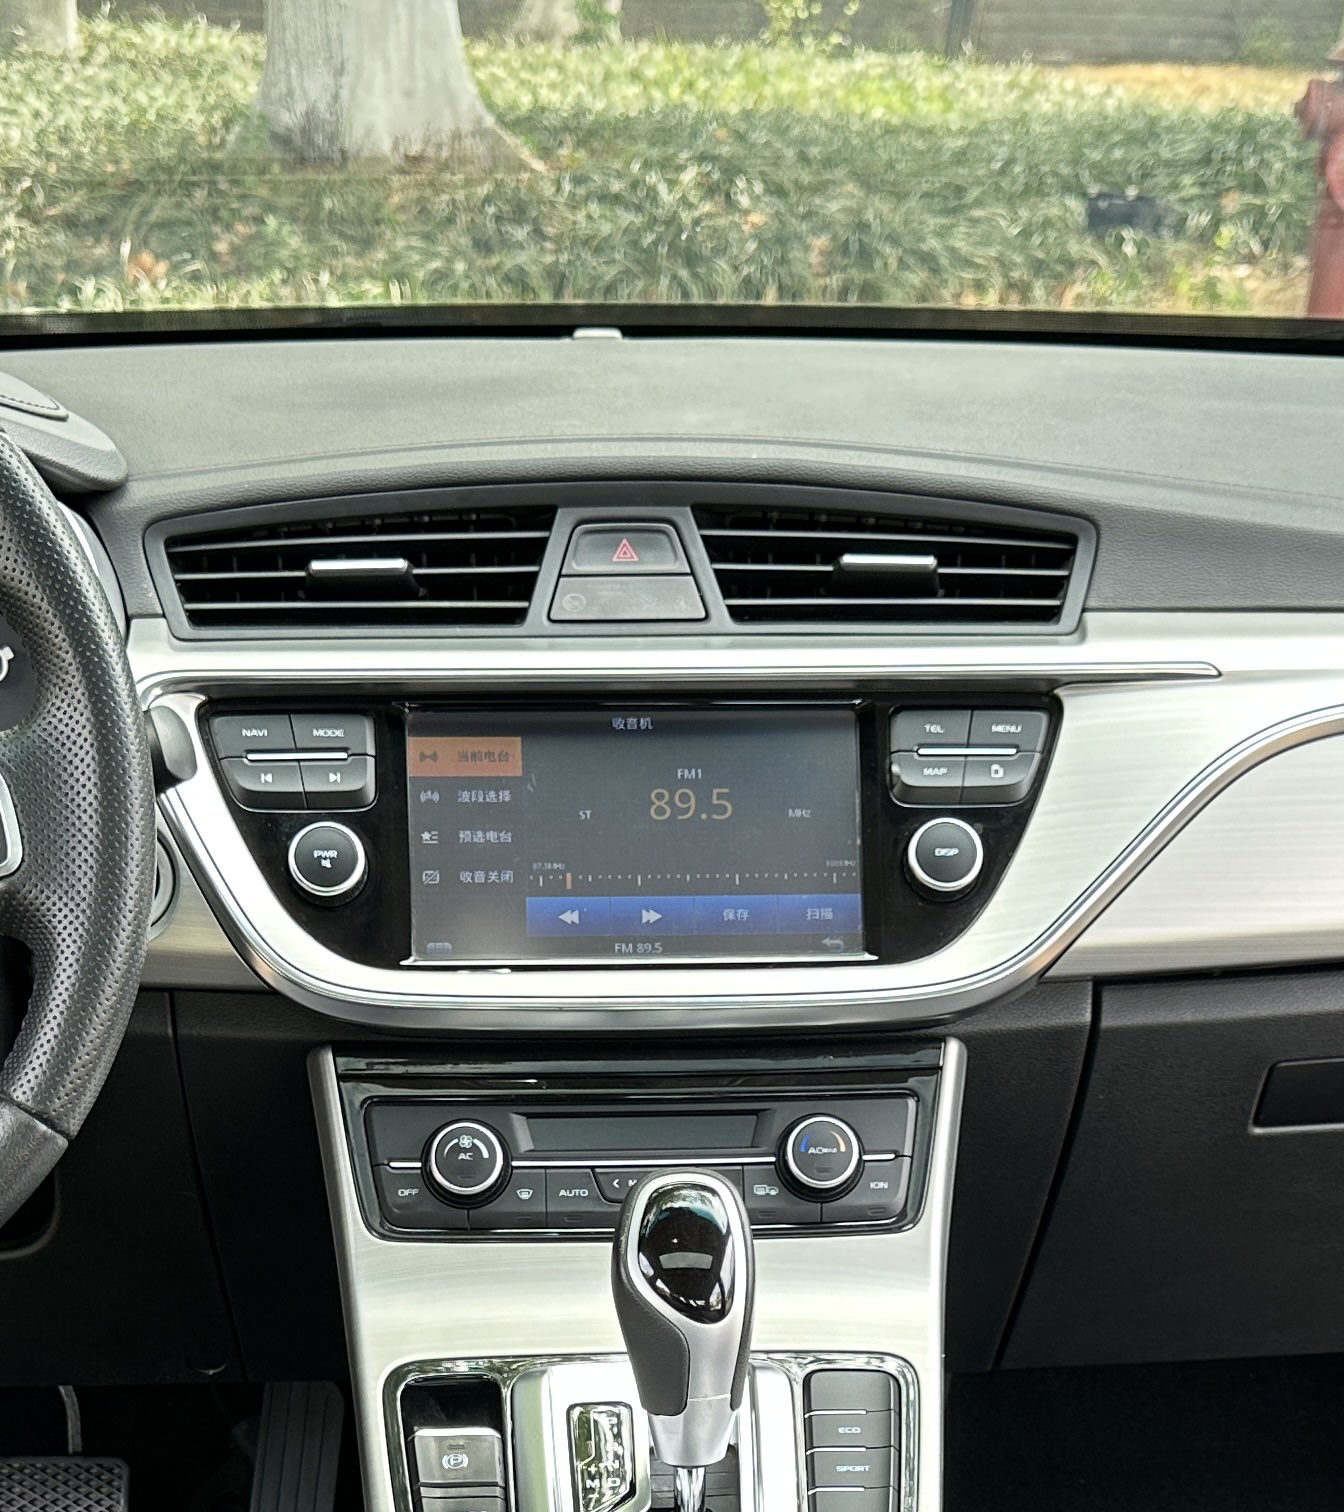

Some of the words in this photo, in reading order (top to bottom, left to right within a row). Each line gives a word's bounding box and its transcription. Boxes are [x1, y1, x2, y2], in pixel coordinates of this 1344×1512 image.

[612, 717, 653, 730] 收音机
[924, 724, 944, 733] TEL
[991, 724, 1022, 733] MENU
[242, 728, 268, 737] NAVI
[312, 728, 345, 738] MODE
[457, 750, 510, 763] 当前电台
[676, 768, 702, 780] FM1
[923, 767, 948, 776] MAP
[457, 790, 512, 803] 波段选择
[649, 788, 734, 821] 89.5
[578, 810, 593, 820] ST
[787, 808, 812, 818] MHz
[458, 830, 513, 843] 预选电台
[313, 850, 338, 859] PWR
[459, 870, 514, 884] 收音关闭
[721, 908, 751, 921] 保存
[805, 908, 834, 921] 扫描
[614, 942, 633, 953] FM
[636, 942, 663, 953] 89.5
[458, 1152, 474, 1161] AC
[869, 1181, 888, 1189] ION
[398, 1188, 419, 1197] OFF
[558, 1188, 589, 1197] AUTO
